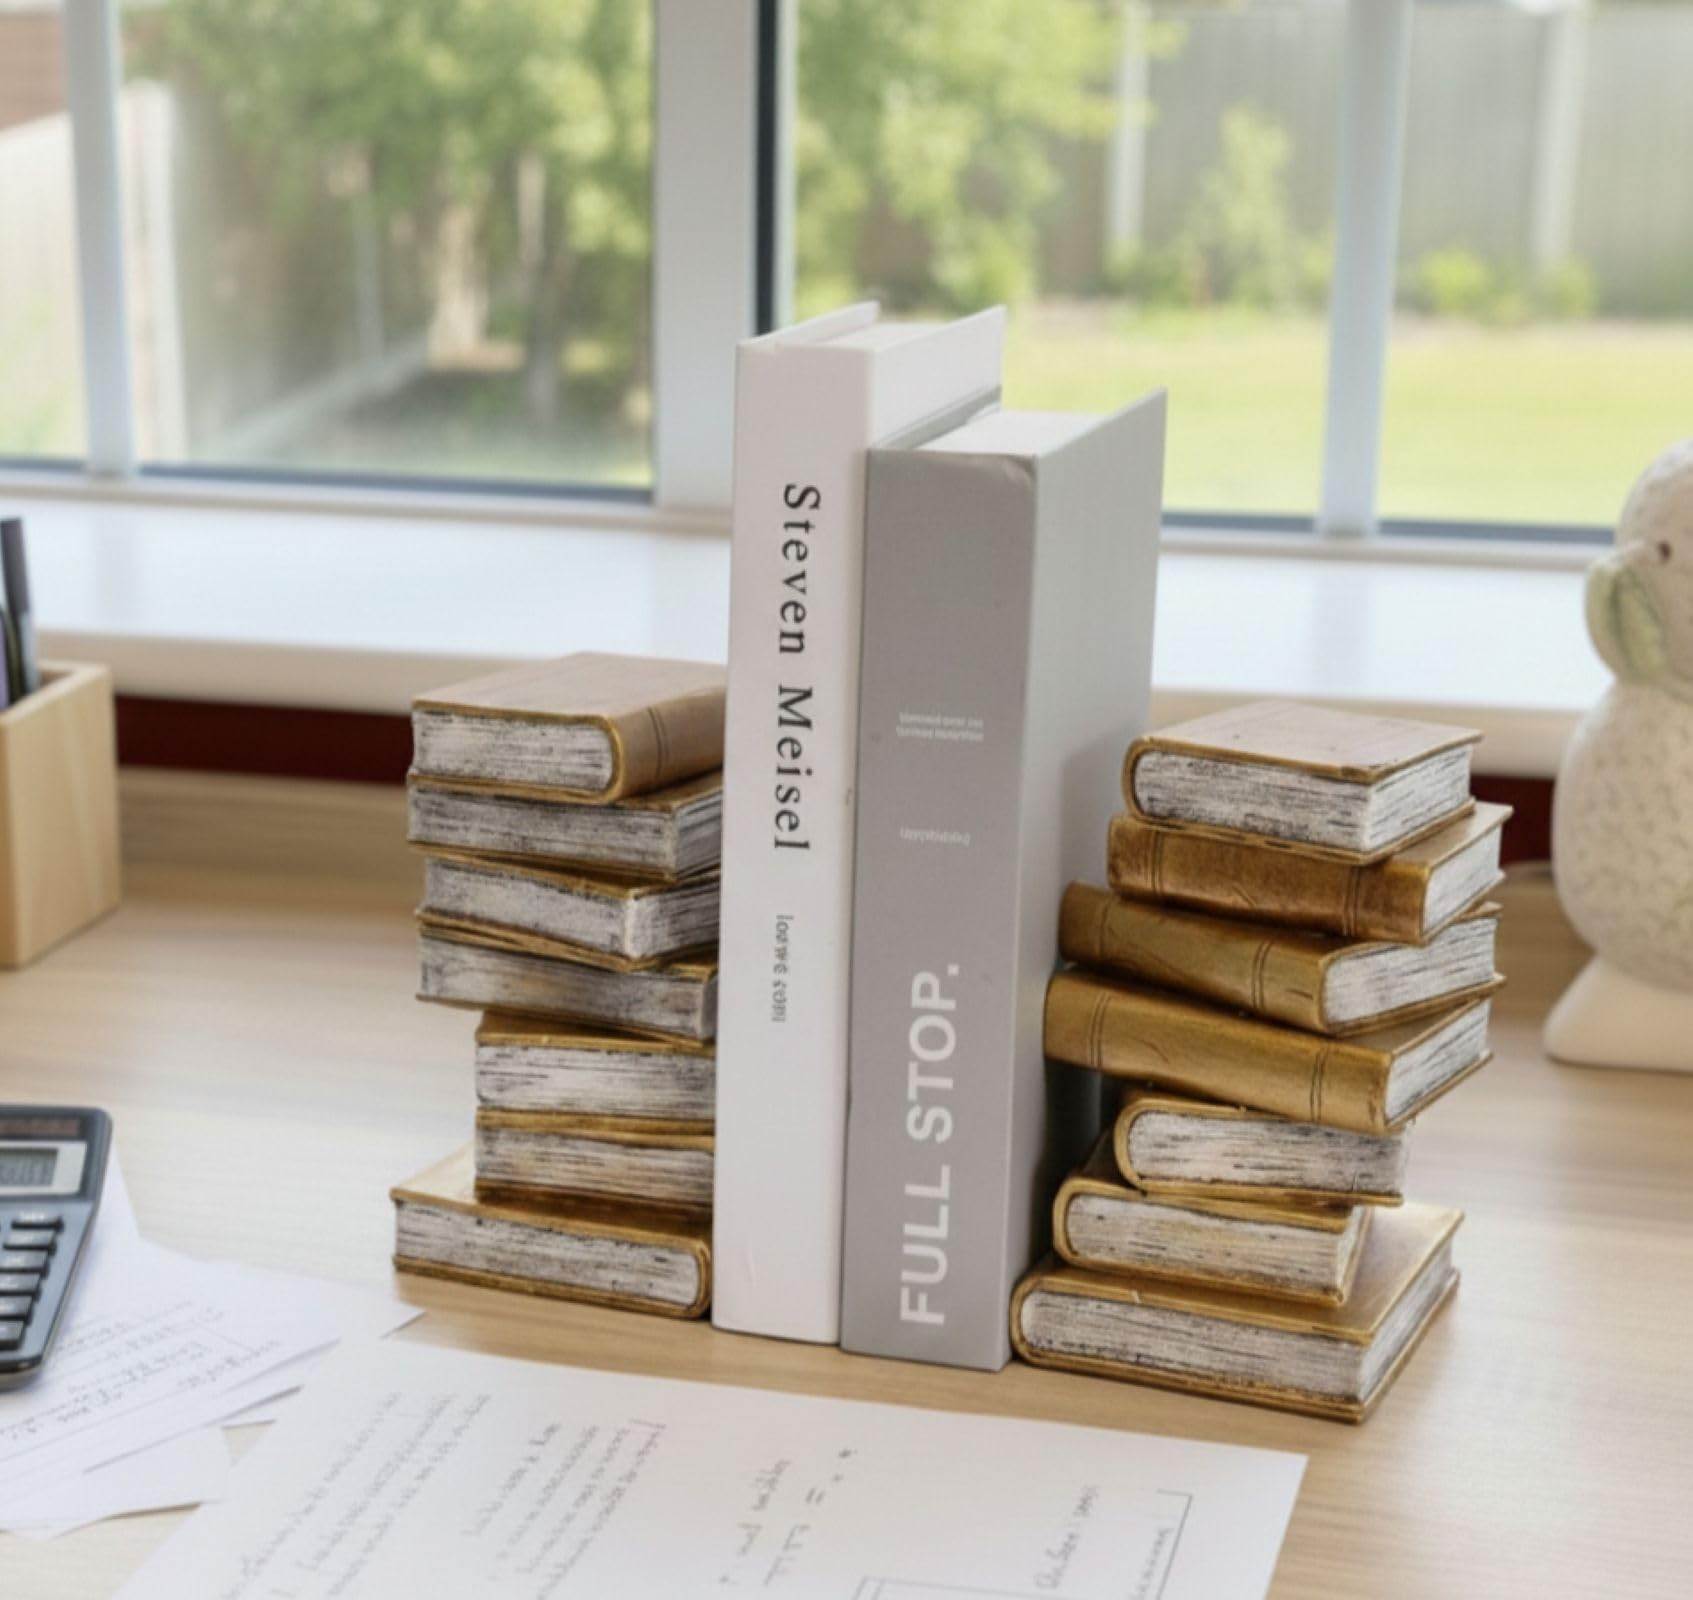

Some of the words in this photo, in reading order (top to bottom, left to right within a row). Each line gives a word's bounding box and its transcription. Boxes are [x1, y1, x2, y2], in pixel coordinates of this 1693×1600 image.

[778, 483, 822, 655] Steven
[774, 684, 813, 851] Meisel
[904, 963, 959, 1144] STOP.
[899, 1164, 951, 1326] FULL
